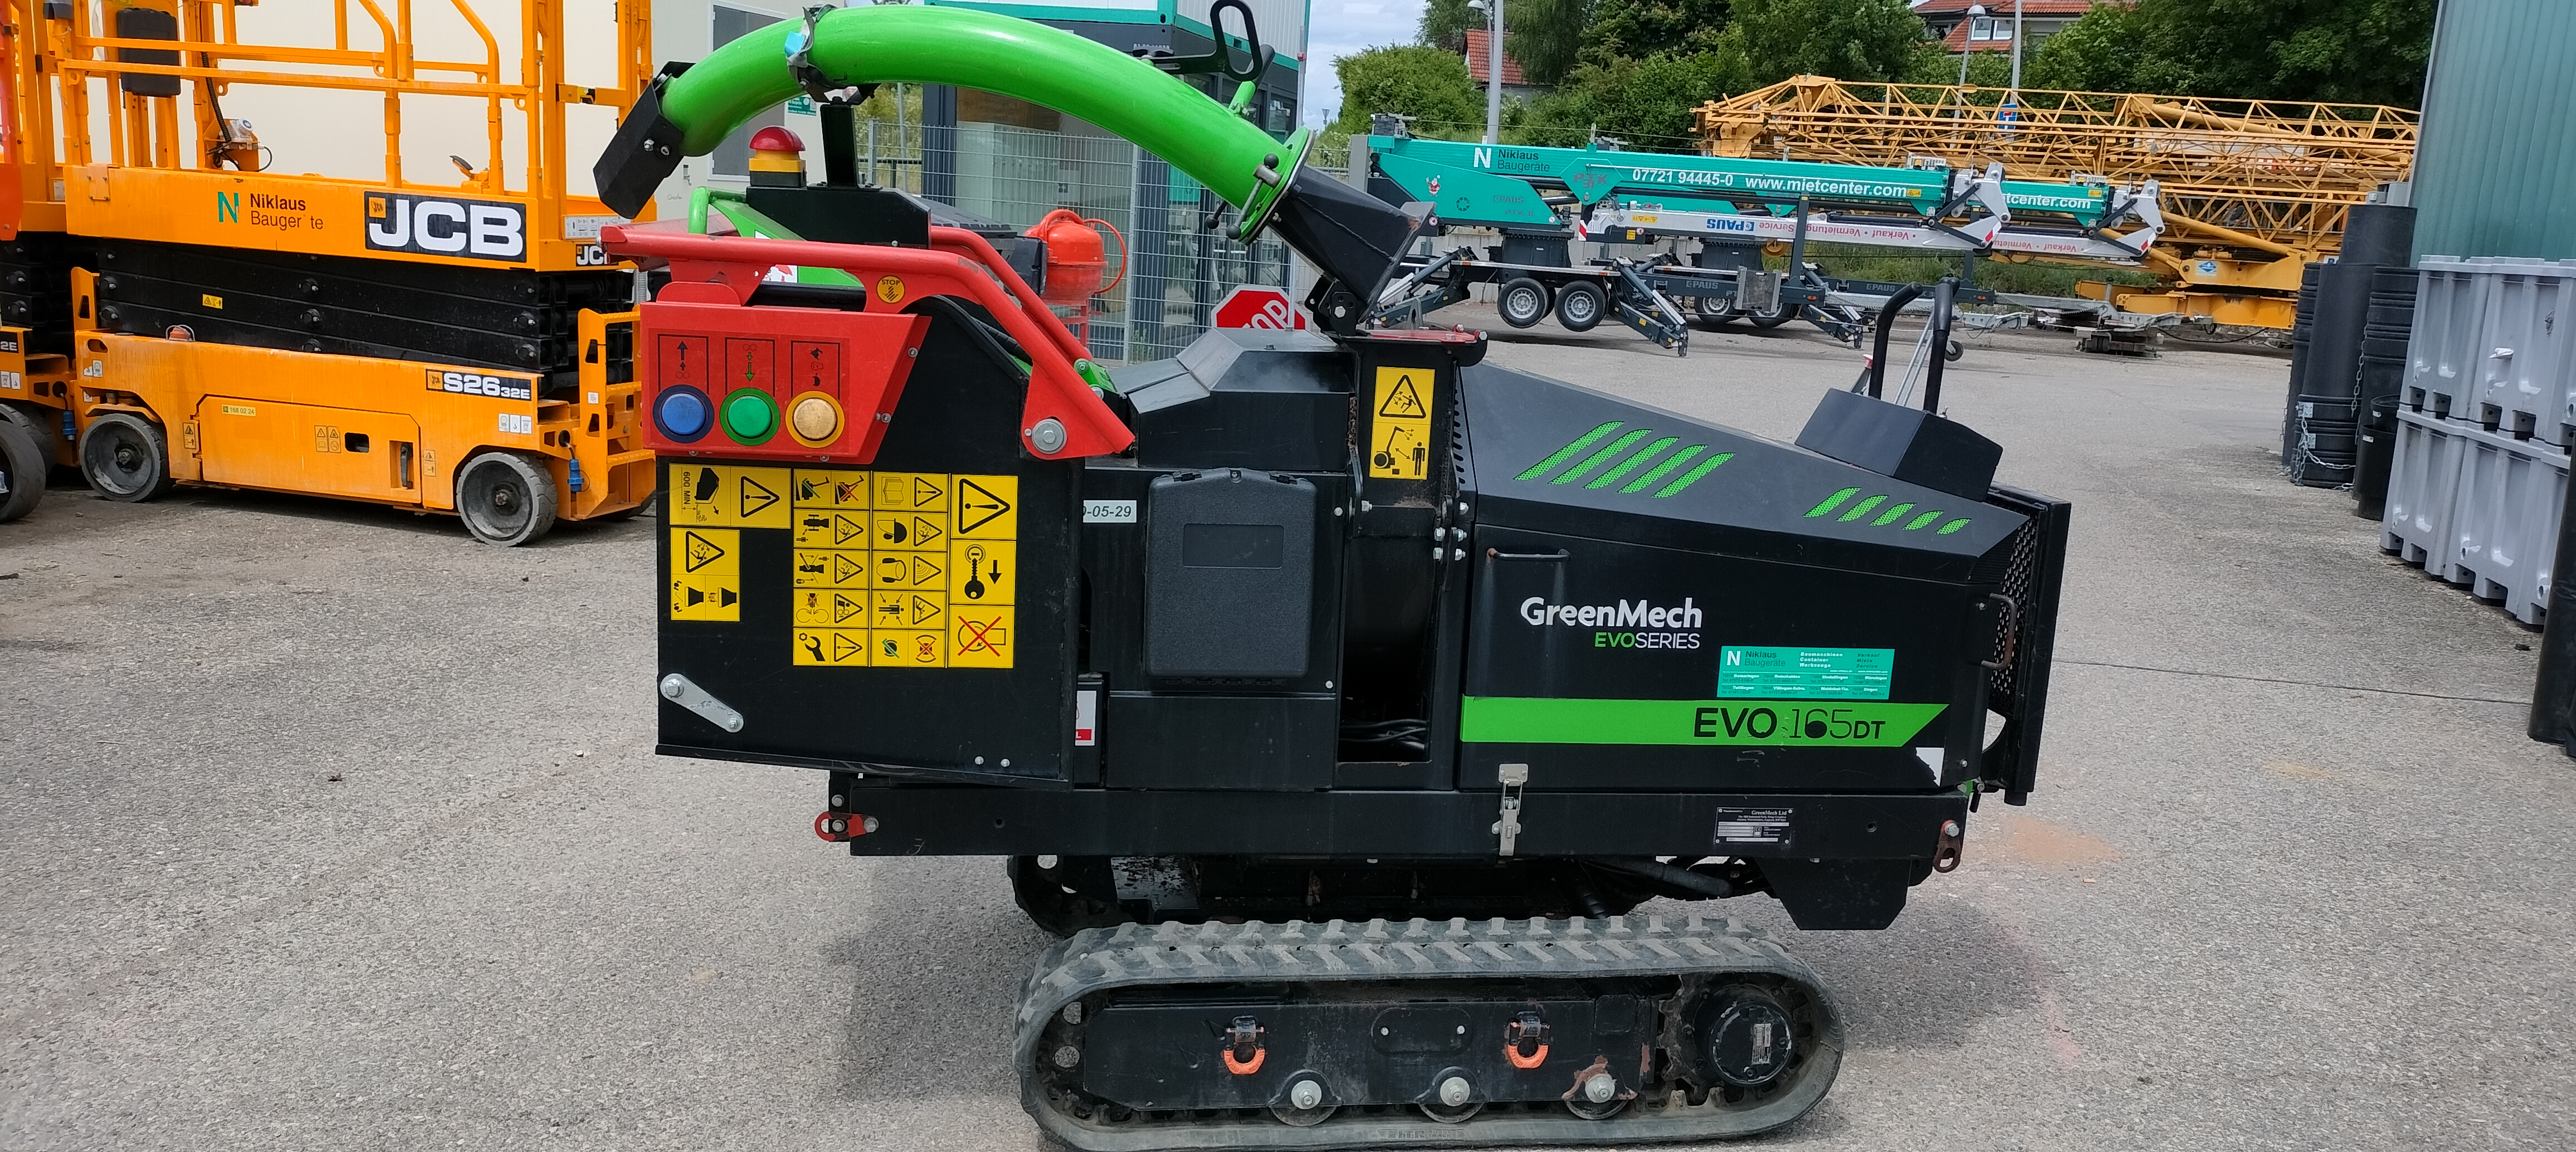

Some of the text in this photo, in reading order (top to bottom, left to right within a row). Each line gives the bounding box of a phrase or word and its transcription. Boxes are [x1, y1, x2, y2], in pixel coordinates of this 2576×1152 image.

[1474, 147, 1491, 168] N
[1498, 149, 1539, 160] Niklaus
[1497, 159, 1550, 173] Baugeräte
[1632, 168, 1673, 183] 07721
[1678, 171, 1734, 186] 94445-0
[1745, 177, 1907, 197] www.mietcenter.com
[218, 192, 239, 223] N
[250, 193, 306, 211] Niklaus
[251, 211, 323, 231] Baugerte
[369, 199, 524, 256] JCB
[1759, 222, 1794, 232] Service
[1872, 230, 1909, 240] Verkauf
[577, 246, 608, 265] JC
[2043, 243, 2076, 252] Verkauf
[1520, 597, 1702, 628] GreenMech
[1727, 650, 1741, 666] N
[1744, 658, 1786, 668] Baugeräte
[1694, 707, 1778, 738] EVO
